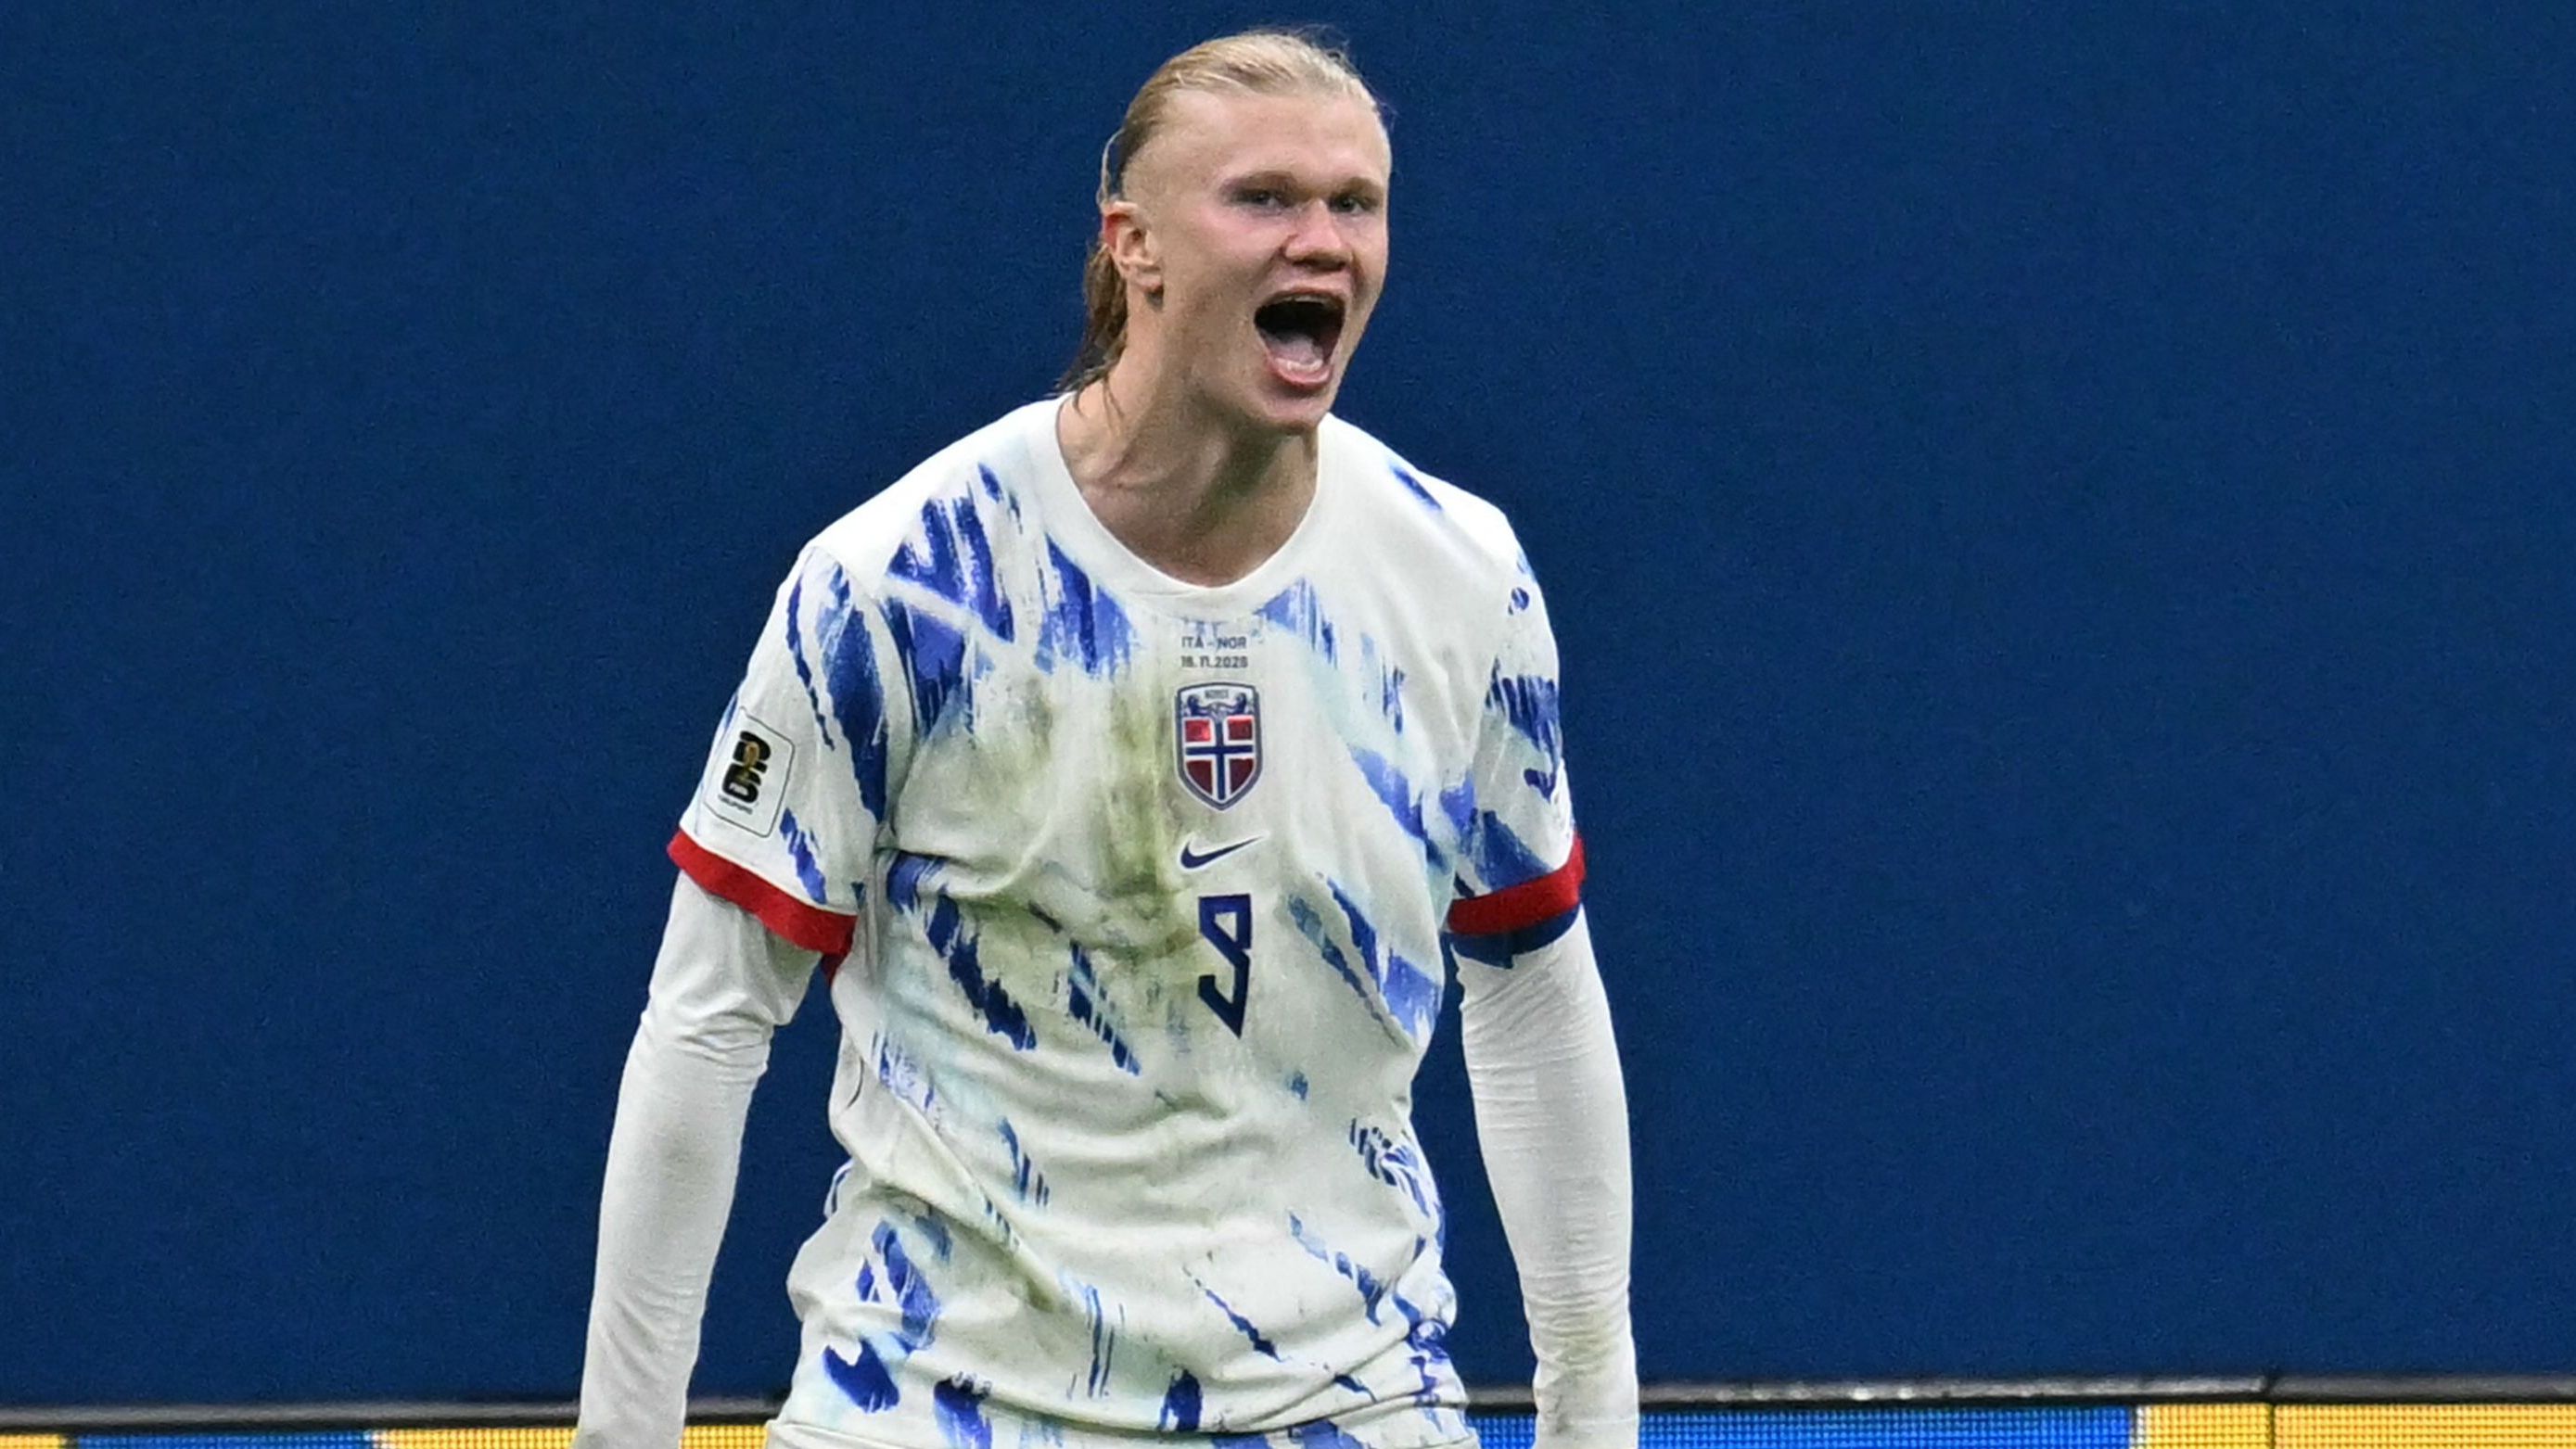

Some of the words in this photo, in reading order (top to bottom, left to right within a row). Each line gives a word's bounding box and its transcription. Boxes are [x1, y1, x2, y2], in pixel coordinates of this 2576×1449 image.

[1181, 636, 1204, 648] ITA
[1218, 636, 1247, 649] NOR
[1198, 893, 1252, 1040] 9
